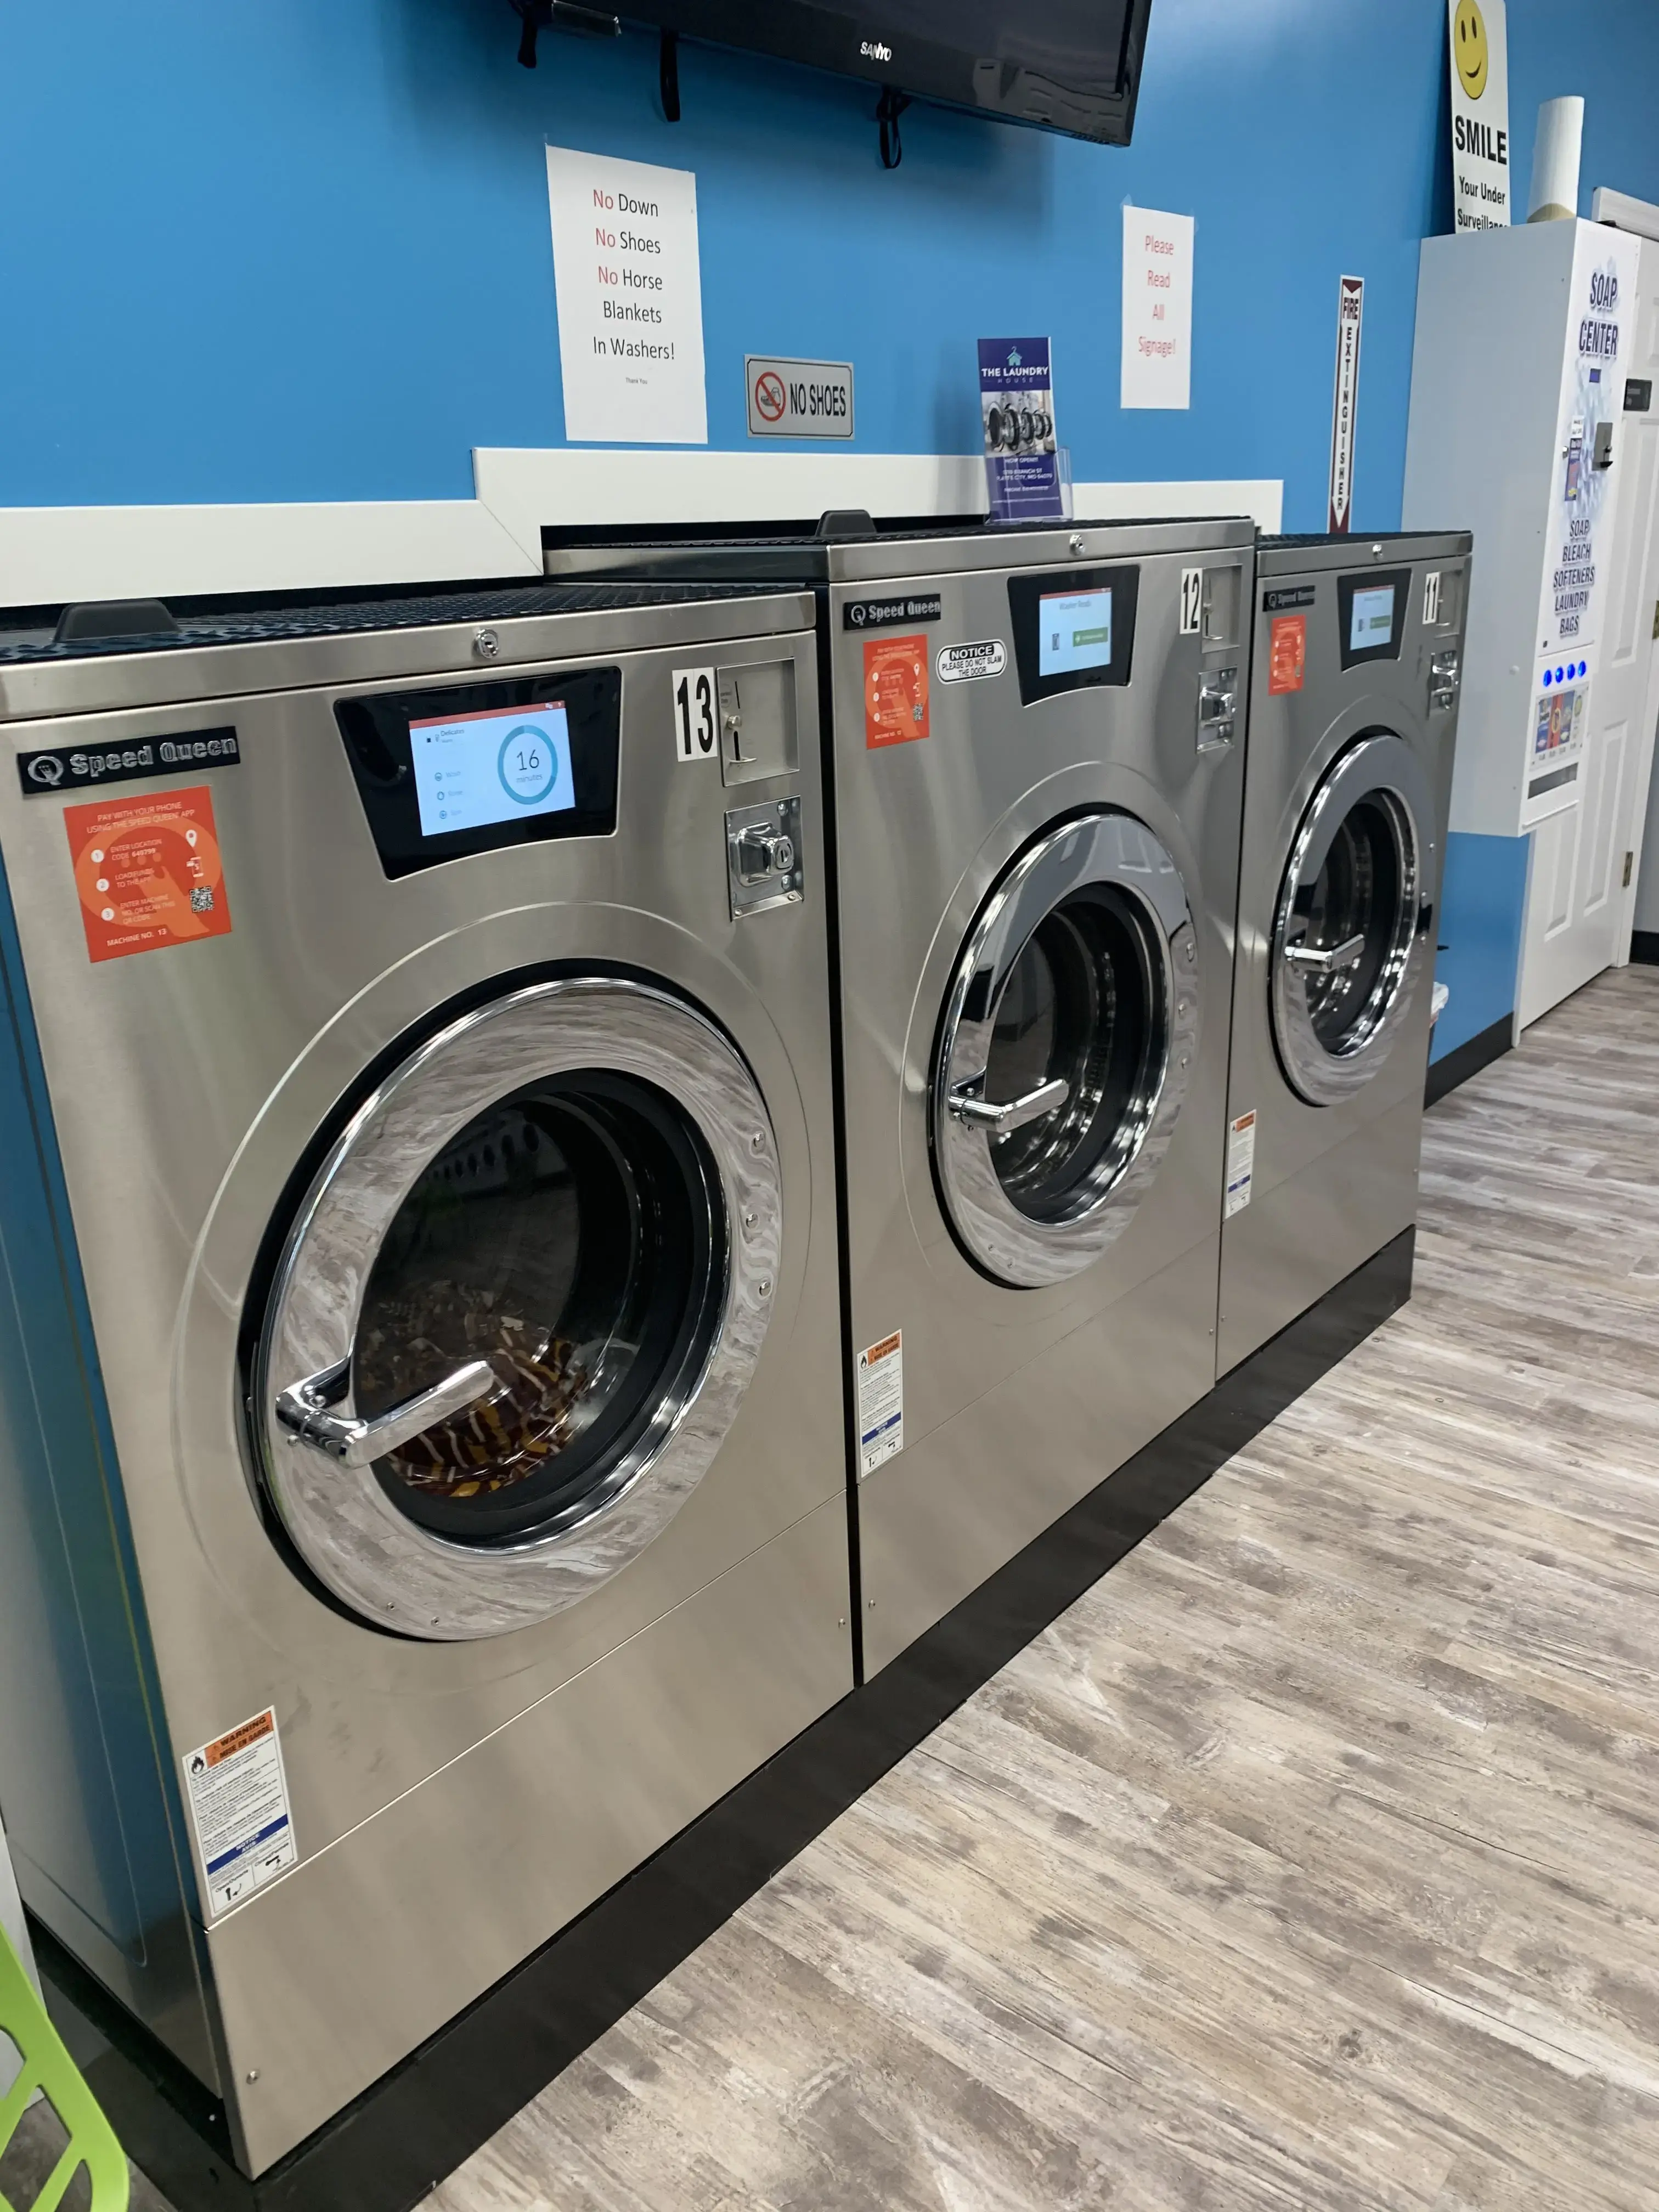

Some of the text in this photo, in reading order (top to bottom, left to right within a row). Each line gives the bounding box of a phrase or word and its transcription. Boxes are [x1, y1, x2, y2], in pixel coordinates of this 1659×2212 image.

[860, 41, 892, 61] SANYO
[1455, 115, 1507, 165] SMILE
[1459, 175, 1505, 205] Your Under
[593, 189, 658, 217] No Down
[1458, 208, 1508, 230] Surveilla
[596, 228, 661, 254] No Shoes
[1145, 235, 1174, 255] Please
[598, 266, 662, 291] No Horse
[1147, 269, 1170, 288] Read
[1590, 273, 1617, 308] SOAP
[603, 301, 662, 324] Blankets
[1152, 303, 1165, 320] All
[594, 336, 675, 360] In Washers!
[1138, 335, 1176, 358] Signage!
[1579, 320, 1618, 356] CENTER
[981, 366, 1048, 377] THE LAUNDRY
[790, 383, 846, 417] NO SHOES
[1337, 326, 1352, 510] EXTINGUISHER
[1570, 520, 1589, 537] SOAP
[1562, 543, 1591, 562] BLEACH
[1553, 566, 1595, 588] SOFTENERS
[868, 602, 905, 622] Speed
[907, 601, 940, 616] Queen
[1182, 573, 1199, 630] 12
[1555, 590, 1589, 612] LAUNDRY
[1560, 615, 1579, 634] BAGS
[942, 661, 964, 671] PLEASE
[987, 655, 1002, 664] SLAM
[951, 645, 993, 660] NOTICE
[959, 666, 986, 677] THE DOOR
[677, 674, 713, 755] 13
[441, 729, 465, 737] Delicates
[70, 746, 154, 778] Speed
[159, 738, 237, 763] Queen
[516, 749, 539, 771] 16
[516, 774, 543, 783] minutes
[87, 824, 111, 834] USING
[181, 809, 195, 817] APP
[97, 802, 182, 822] PAY WITH YOUR PHONE
[110, 844, 130, 853] ENTER
[131, 839, 162, 850] LOCATION
[111, 853, 129, 861] CODE
[115, 872, 133, 881] LOAD
[120, 900, 139, 909] ENTER
[106, 928, 166, 946] MACHINE NO. 13
[220, 1717, 267, 1746] WARNING
[220, 1725, 270, 1758] MISE EN GARDE
[236, 1832, 261, 1851] NOTICE
[241, 1841, 256, 1853] AVIS
